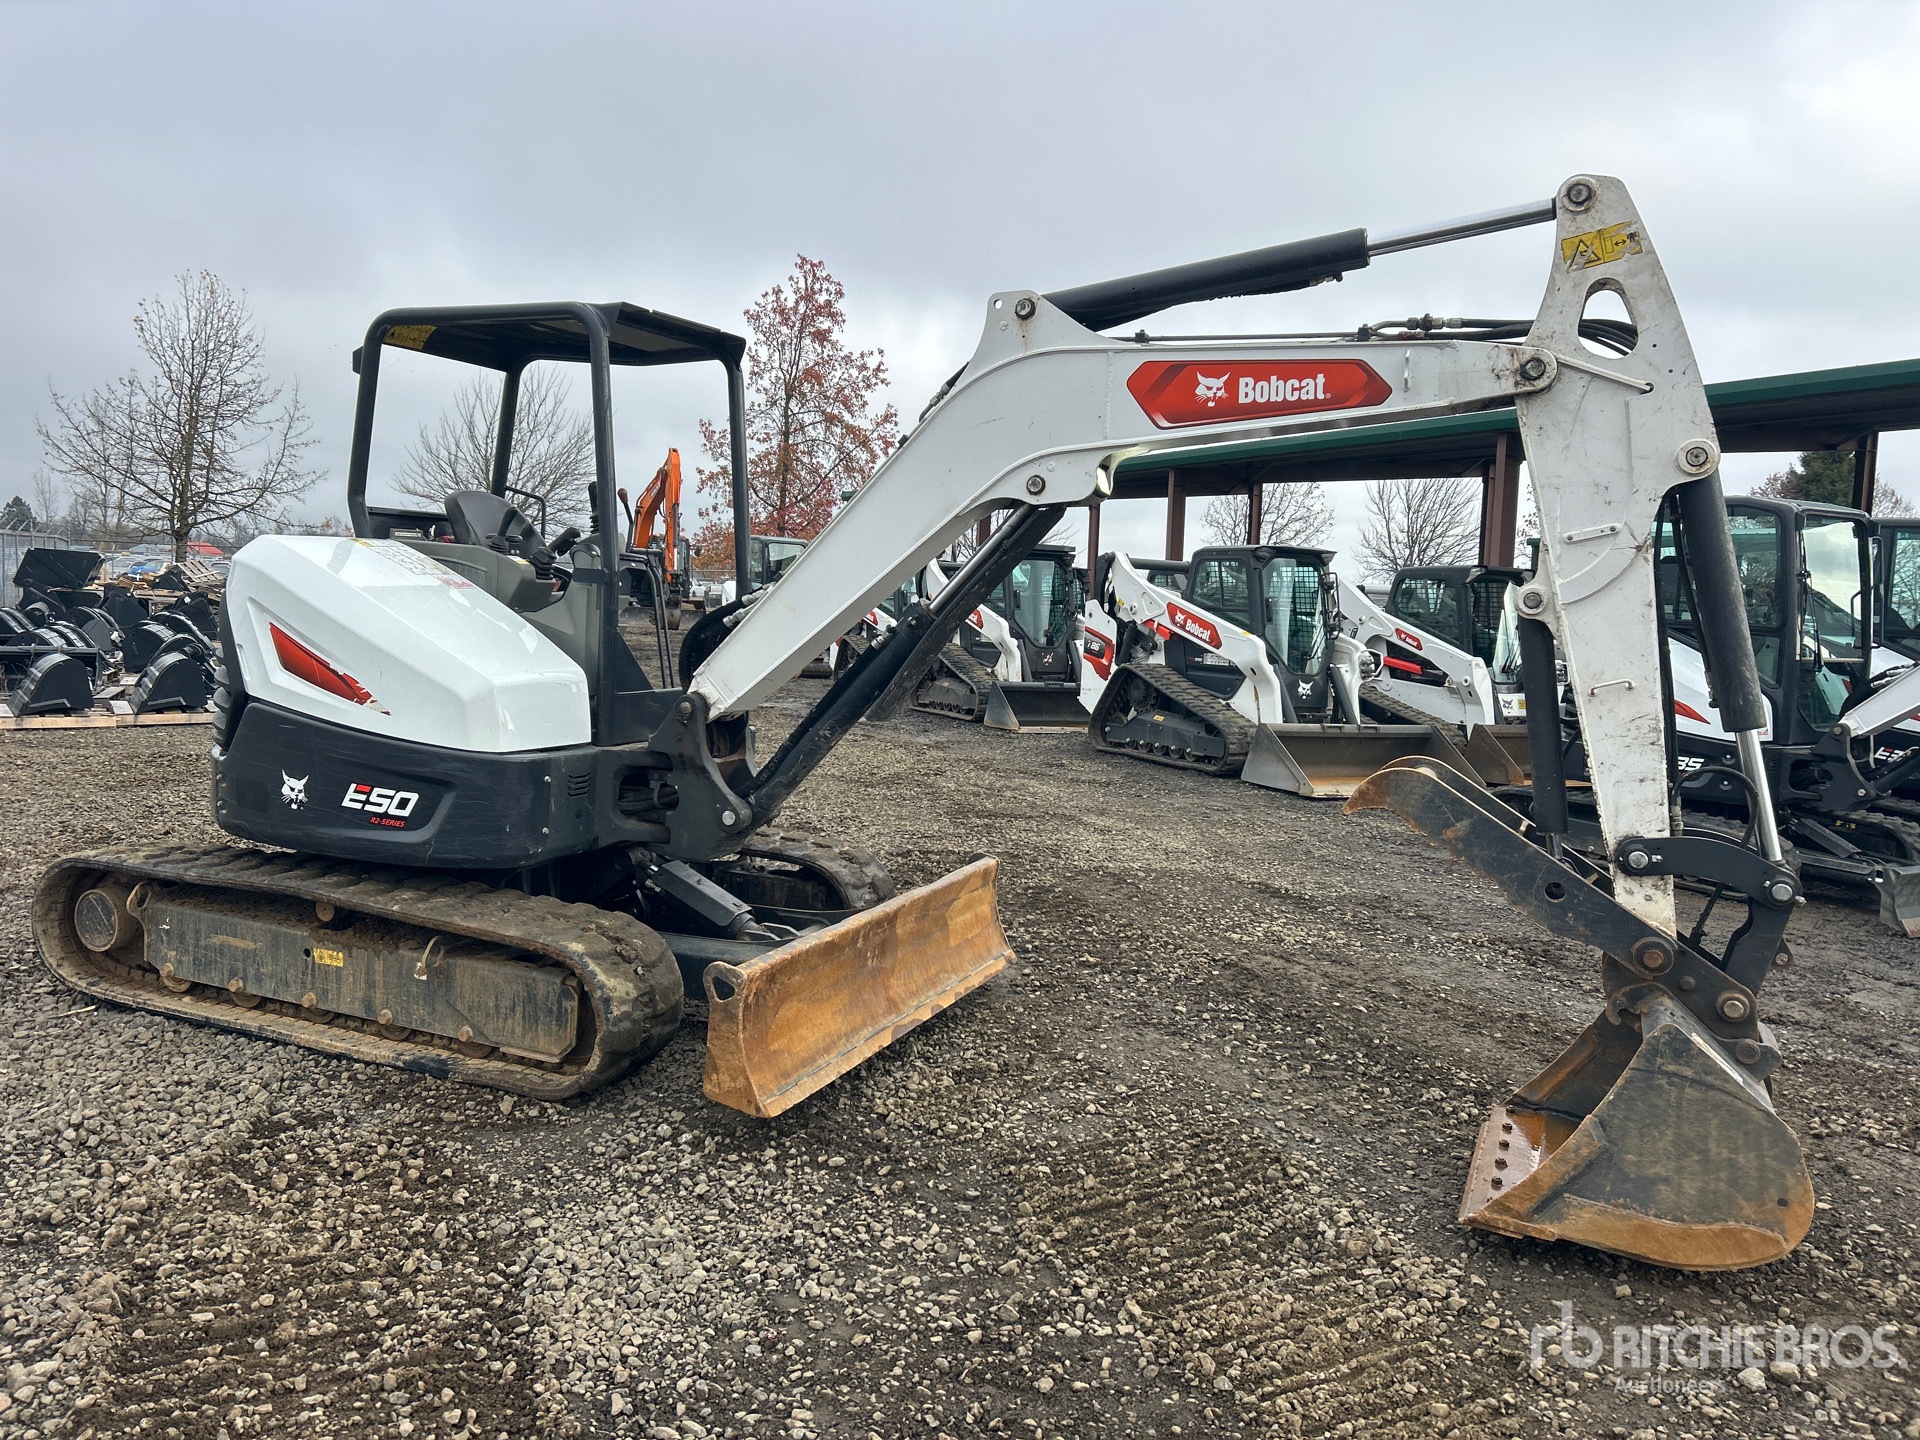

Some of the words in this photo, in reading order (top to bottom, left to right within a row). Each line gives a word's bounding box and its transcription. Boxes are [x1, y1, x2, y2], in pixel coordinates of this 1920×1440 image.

[1238, 373, 1327, 404] Bobcat
[1185, 618, 1211, 642] Bobcat
[1677, 756, 1705, 771] 35
[341, 782, 420, 817] E50
[369, 816, 406, 829] R2-SERIES
